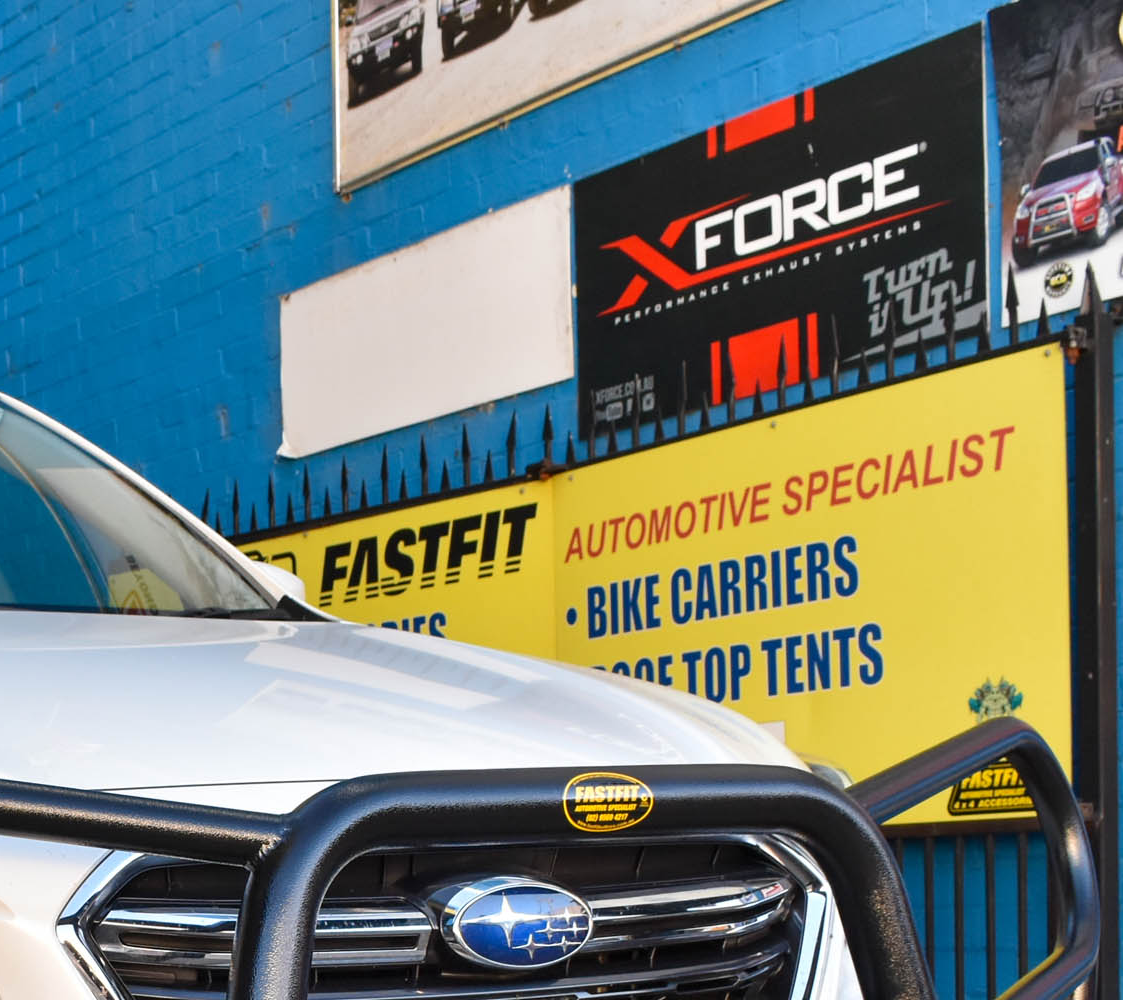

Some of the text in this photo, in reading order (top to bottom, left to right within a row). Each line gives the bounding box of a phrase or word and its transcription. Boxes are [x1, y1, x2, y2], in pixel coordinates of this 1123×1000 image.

[613, 219, 923, 326] PERFORMANCE EXHAUST SYSTEMS
[862, 247, 954, 305] Turn
[563, 425, 1016, 564] AUTOMOTIVE SPECIALIST
[319, 502, 538, 607] FASTFIT
[587, 535, 860, 640] BIKE CARRIERS
[681, 643, 752, 705] TOP
[760, 622, 884, 698] TENTS
[575, 785, 640, 803] FASTFIT
